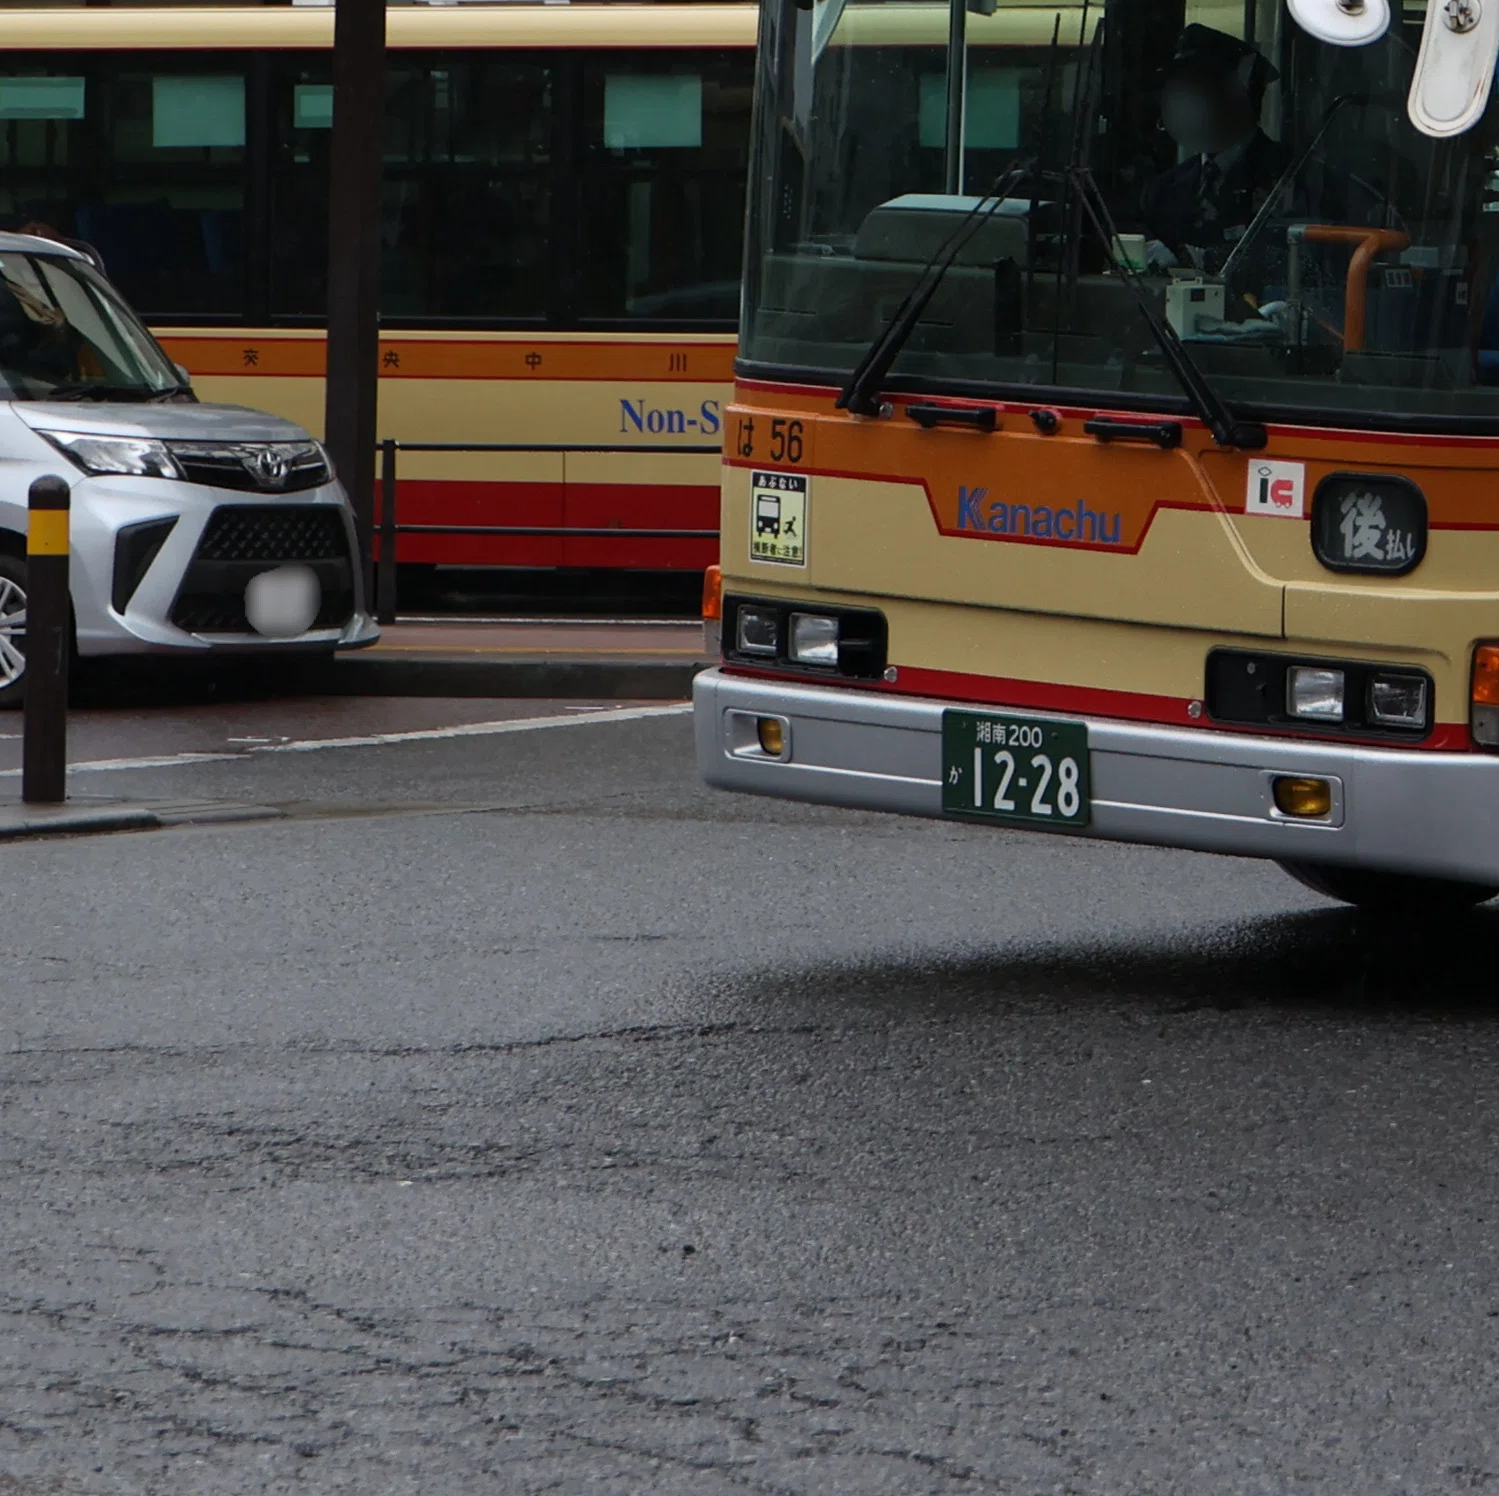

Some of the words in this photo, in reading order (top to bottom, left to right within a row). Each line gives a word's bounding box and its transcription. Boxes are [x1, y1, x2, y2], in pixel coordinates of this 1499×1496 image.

[619, 399, 719, 435] Non-S
[737, 415, 755, 458] は
[770, 419, 804, 463] 56
[758, 475, 799, 490] あぶない
[957, 486, 1121, 543] Kanachu
[949, 764, 963, 785] か
[974, 747, 1080, 818] 12-28
